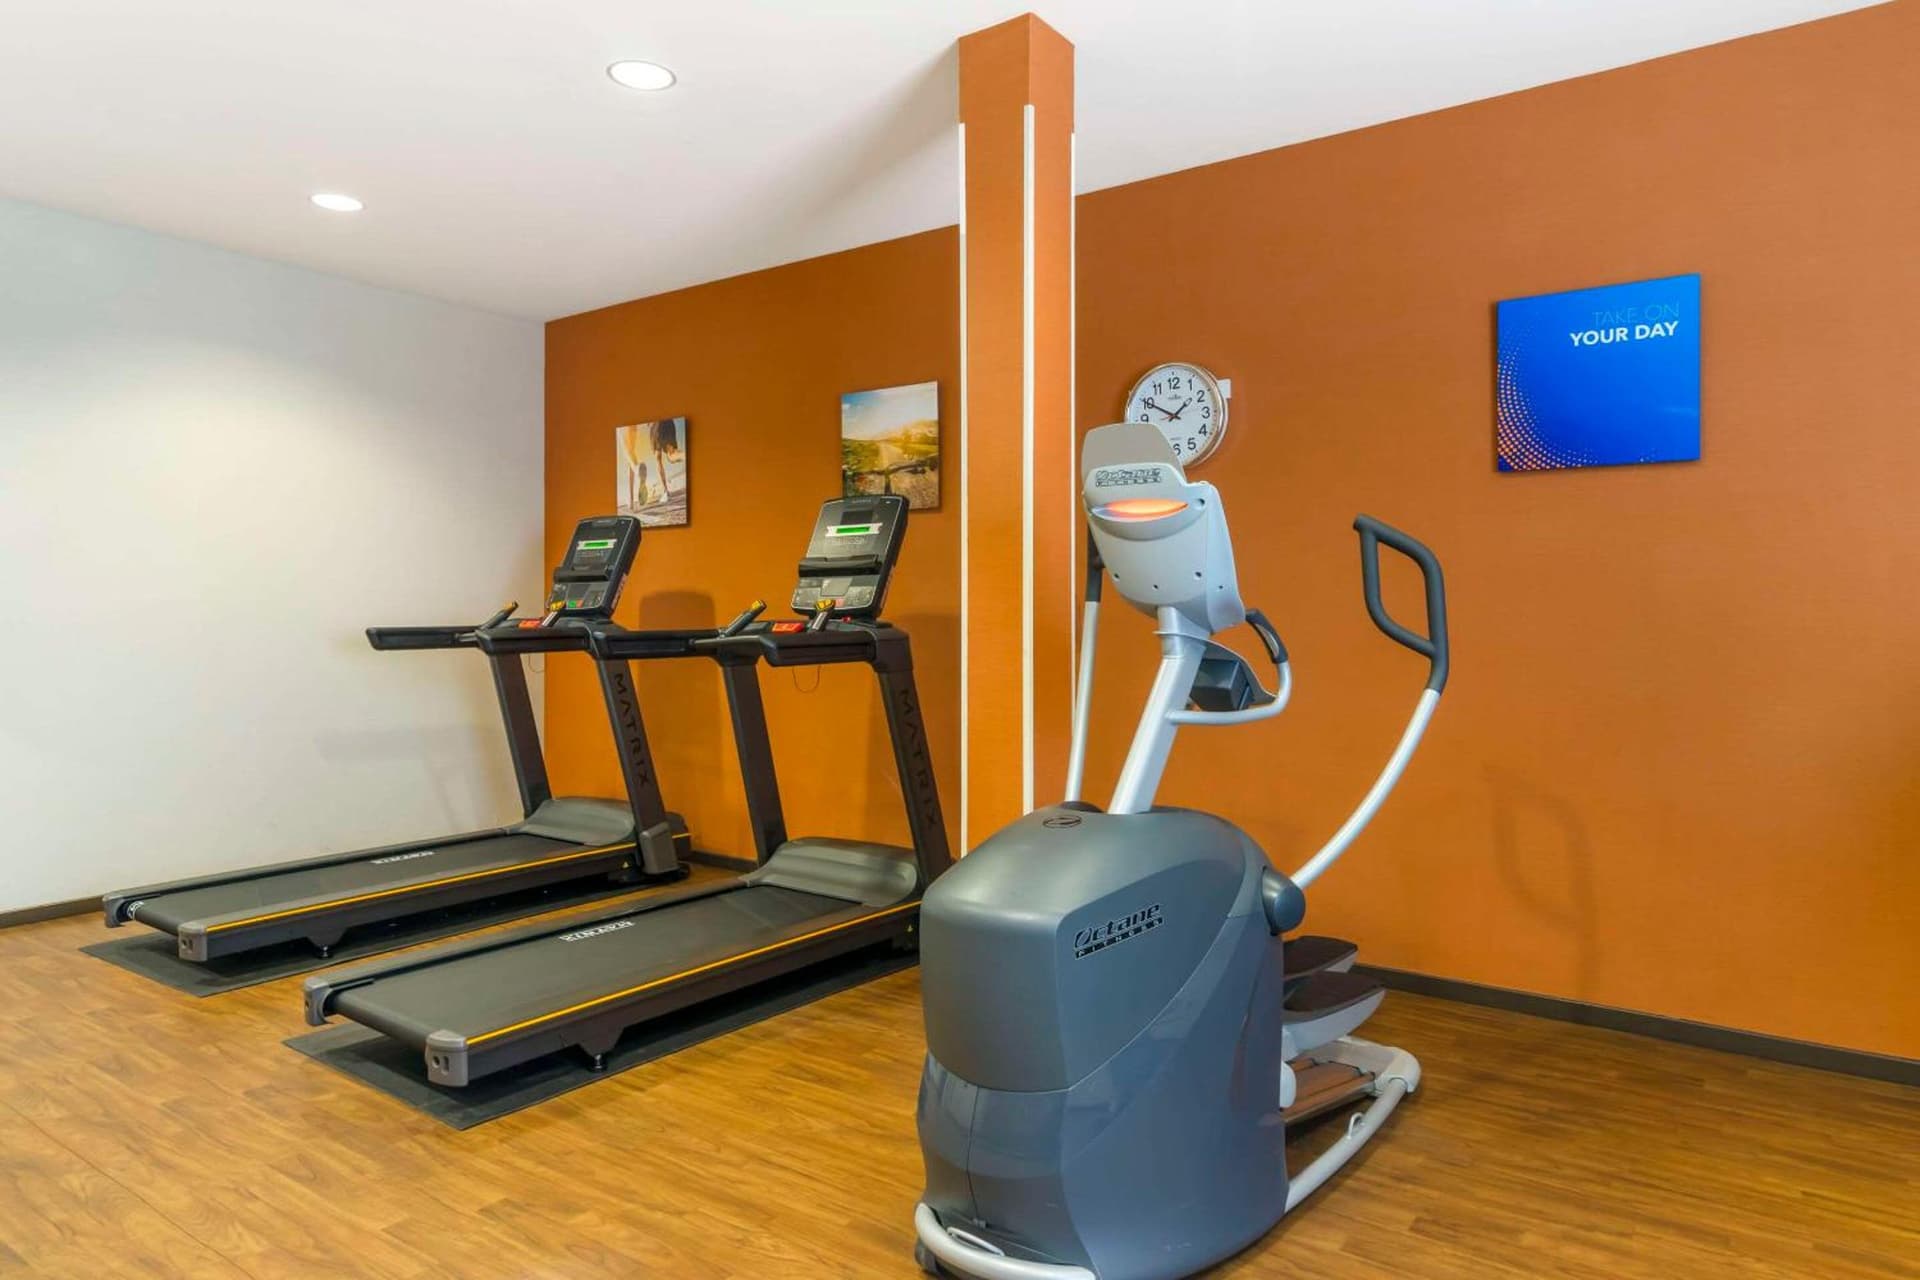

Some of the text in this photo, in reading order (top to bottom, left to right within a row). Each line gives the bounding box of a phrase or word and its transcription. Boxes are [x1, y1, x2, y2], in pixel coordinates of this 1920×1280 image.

[1592, 303, 1679, 327] TAKE ON
[1570, 321, 1679, 347] YOUR DAY
[1153, 383, 1162, 395] 11
[1168, 376, 1181, 390] 12
[1187, 379, 1194, 391] 1
[1196, 390, 1206, 403] 2
[1142, 397, 1155, 410] 10
[1201, 406, 1211, 419] 3
[1198, 424, 1208, 436] 4
[1187, 437, 1197, 450] 5
[1074, 904, 1161, 948] Octane
